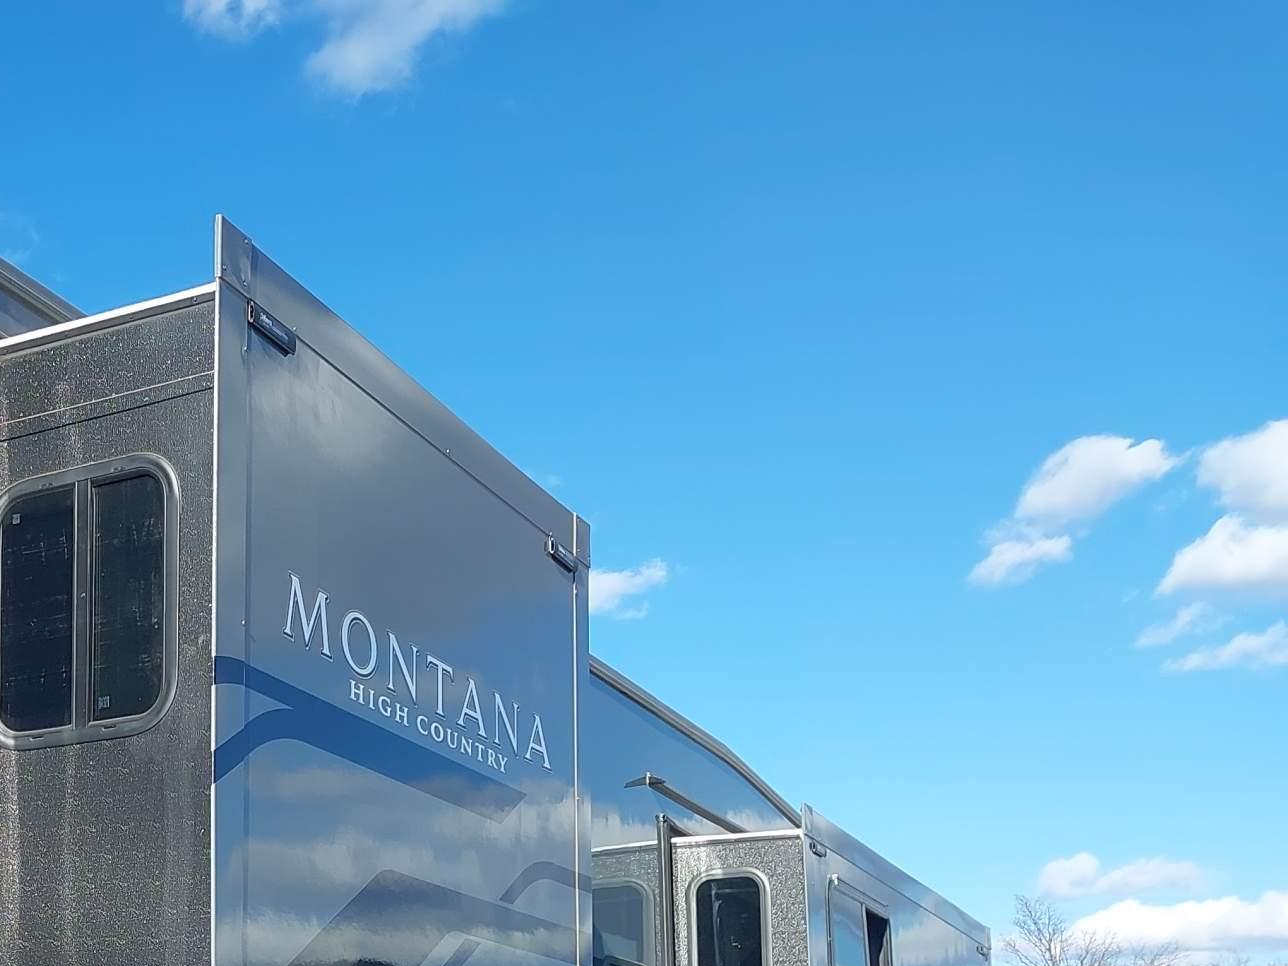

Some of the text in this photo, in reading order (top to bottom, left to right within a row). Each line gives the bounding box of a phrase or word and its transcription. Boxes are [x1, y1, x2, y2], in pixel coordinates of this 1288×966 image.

[282, 571, 553, 774] MONTANA
[349, 680, 508, 774] HIGH COUNTRY
